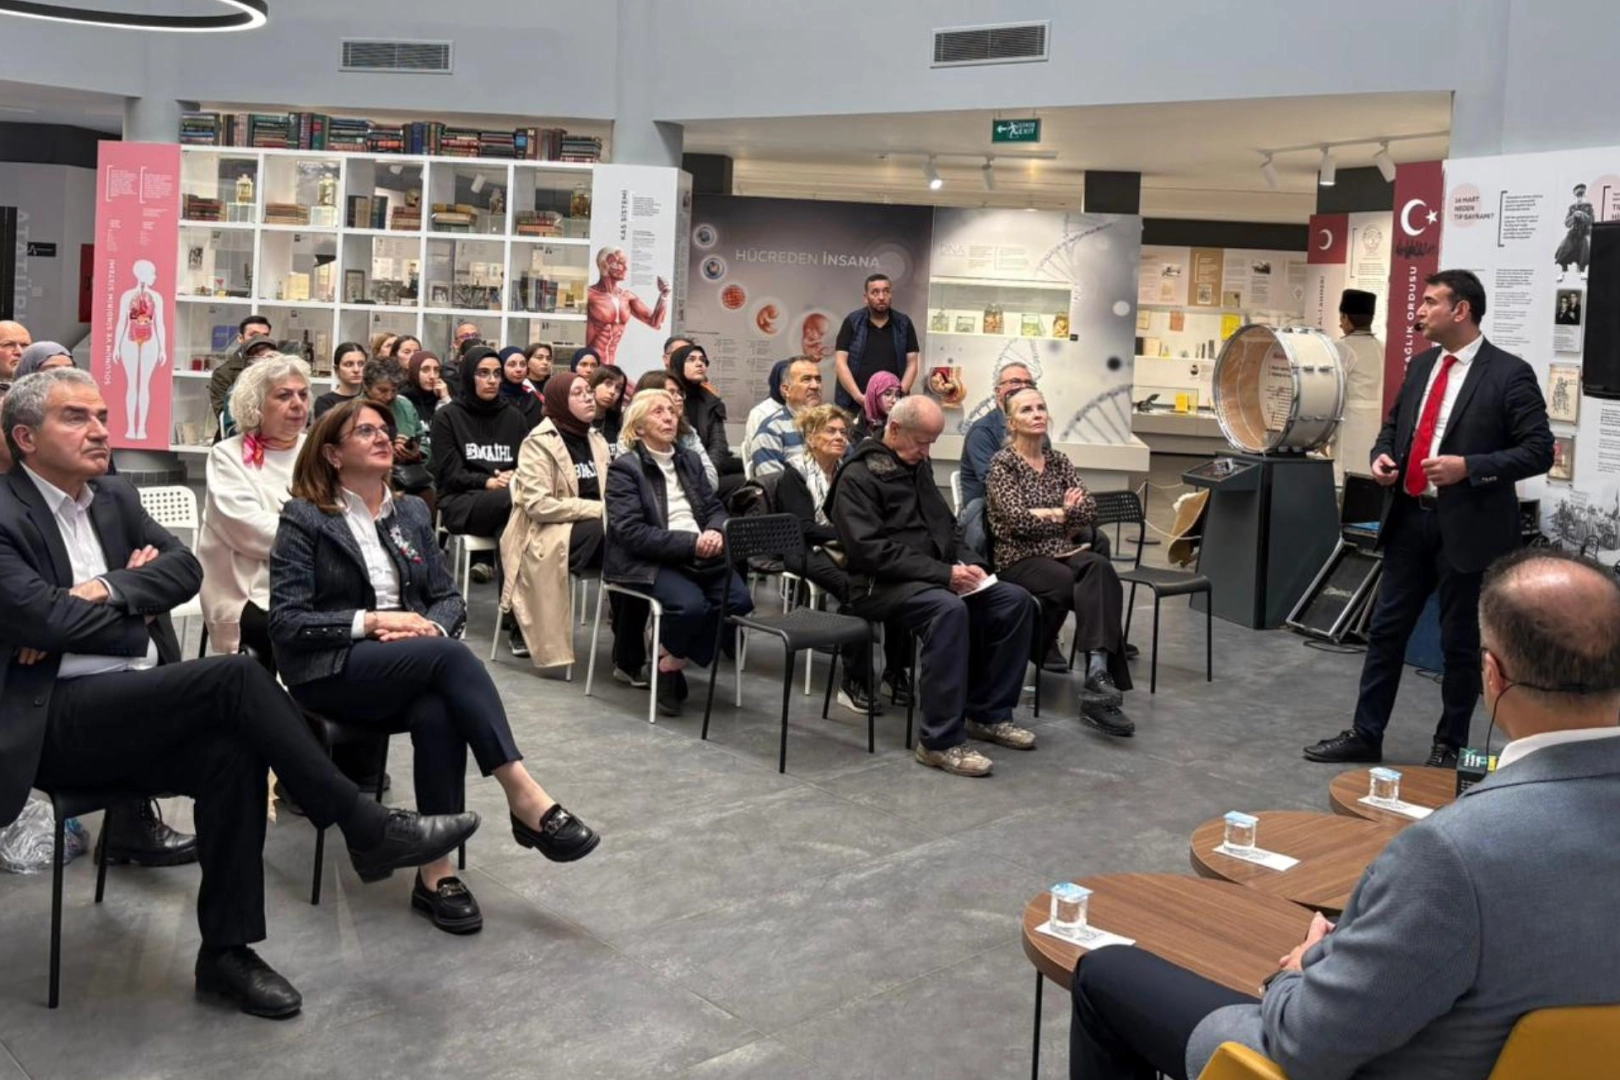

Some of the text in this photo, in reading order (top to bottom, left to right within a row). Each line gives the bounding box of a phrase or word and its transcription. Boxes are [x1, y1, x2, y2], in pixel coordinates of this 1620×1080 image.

[14, 209, 32, 320] ATATÜR
[735, 248, 880, 267] HÜCREDEN İNSANA
[1406, 266, 1417, 320] ORDUSU
